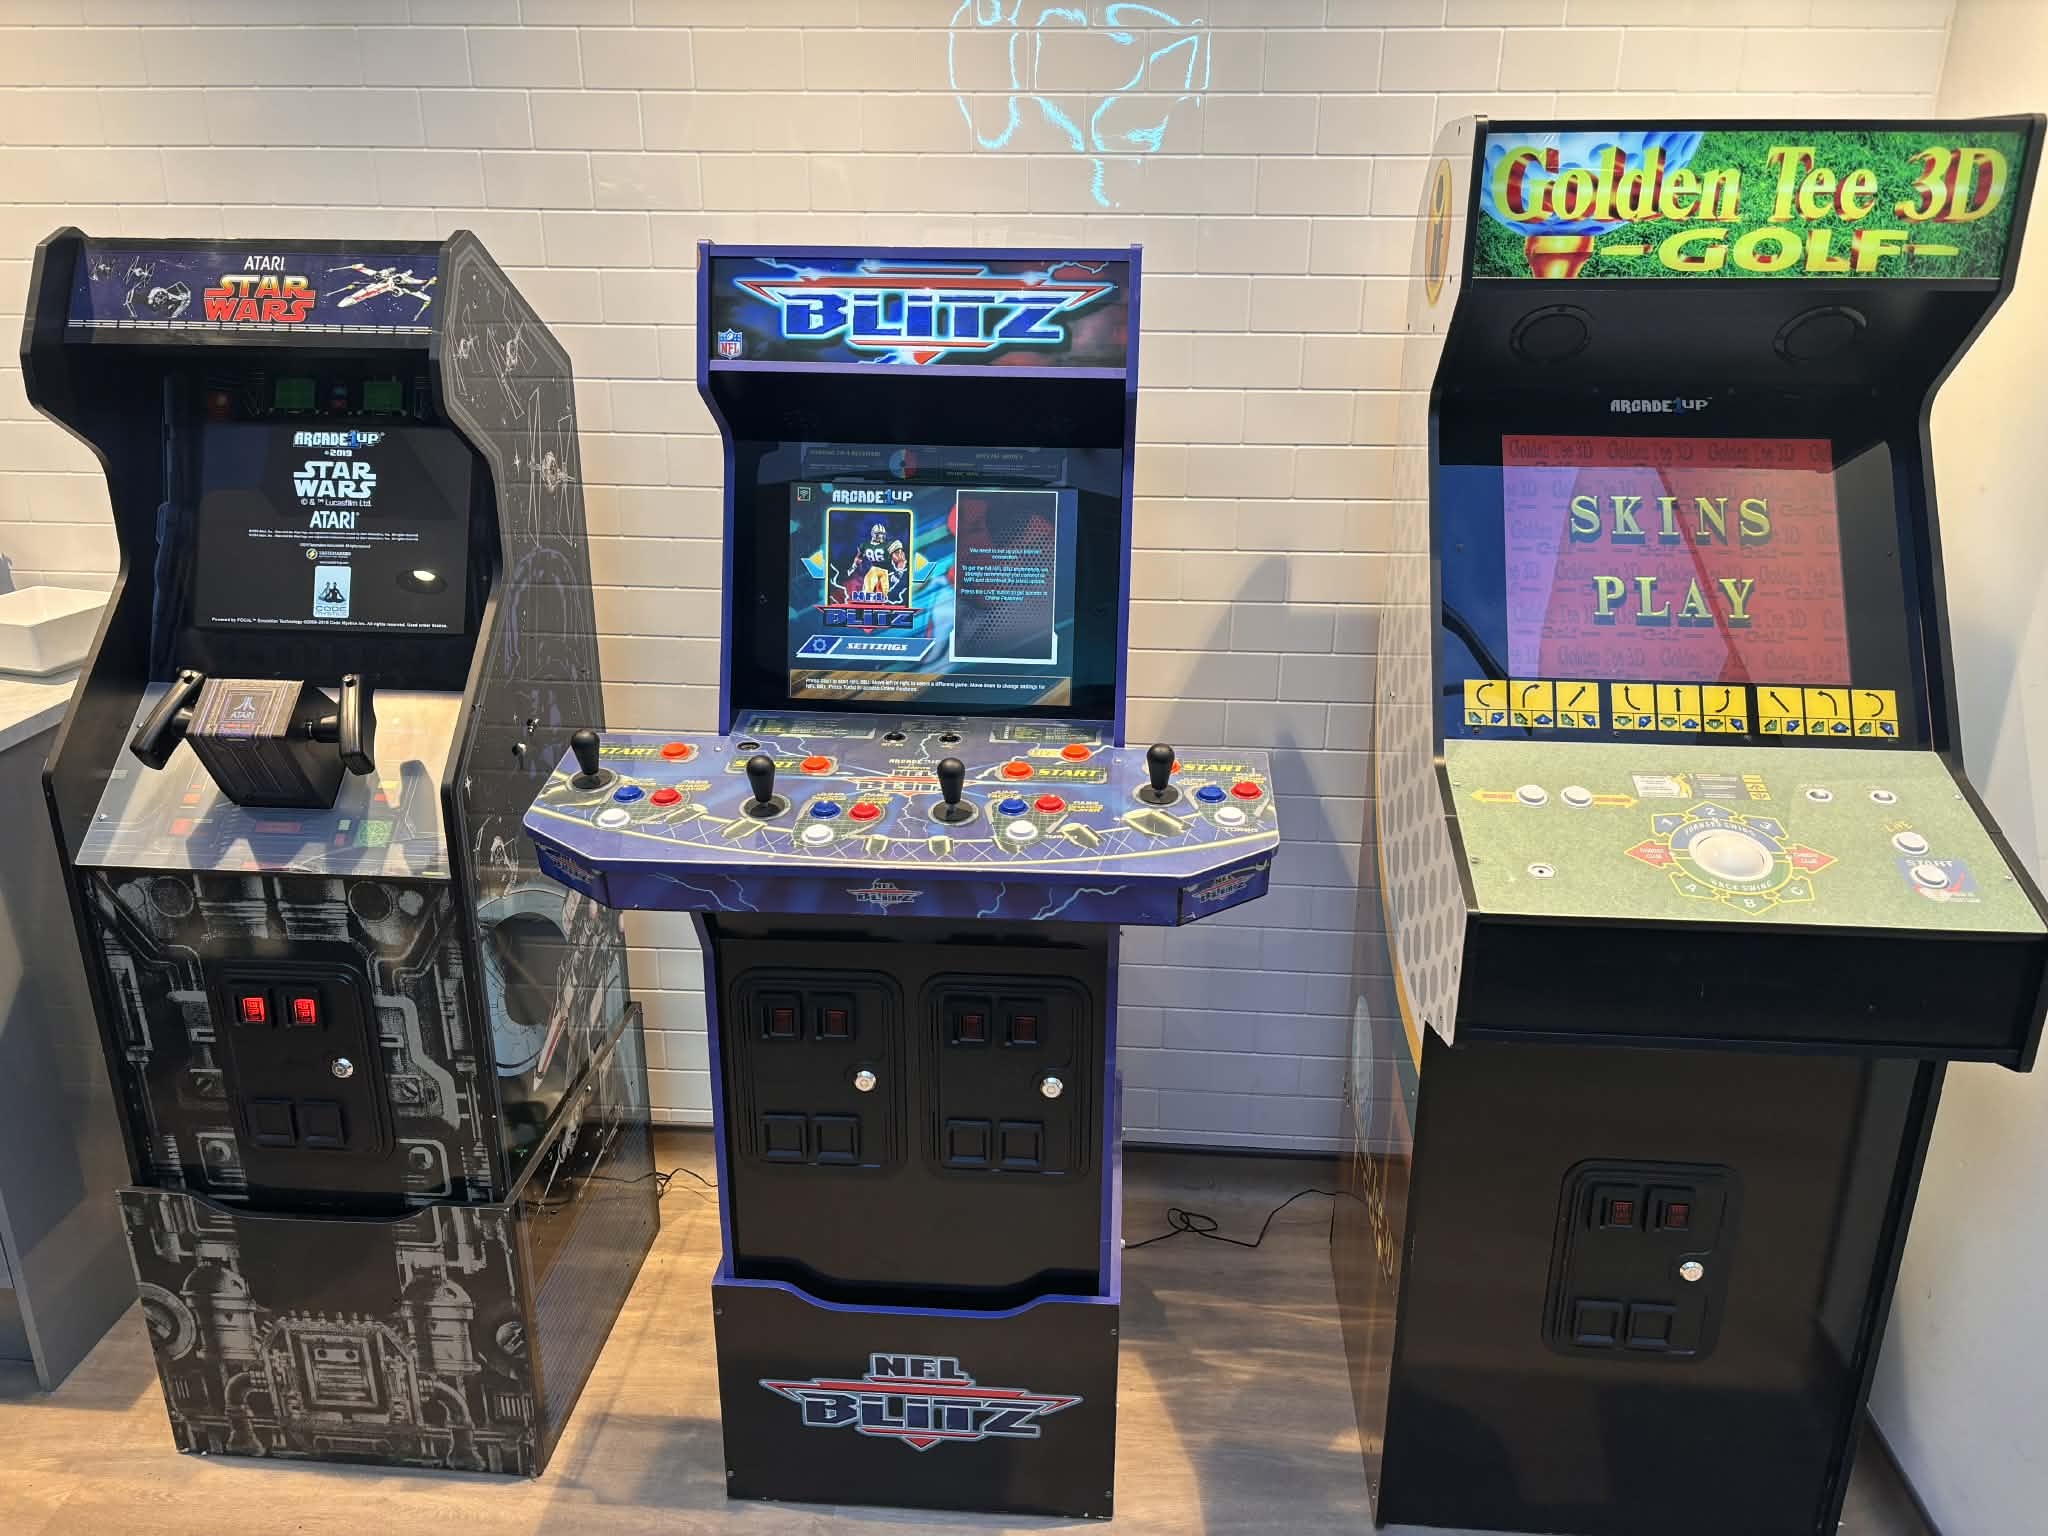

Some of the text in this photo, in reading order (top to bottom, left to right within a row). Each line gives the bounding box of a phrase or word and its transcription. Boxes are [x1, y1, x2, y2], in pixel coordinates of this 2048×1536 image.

[1502, 146, 2009, 223] Golden Tee 3D
[1657, 228, 1910, 272] GOLF
[244, 255, 285, 270] ATARI
[204, 274, 316, 299] STAR
[204, 297, 315, 322] WARS
[776, 291, 1072, 341] BLITZ
[721, 342, 741, 355] NFL
[293, 460, 376, 480] STAR
[293, 480, 376, 498] WARS
[325, 499, 358, 507] Lucasfilm
[309, 510, 355, 528] ATARI
[1570, 494, 1773, 544] SKINS
[1592, 574, 1756, 624] PLAY
[847, 642, 908, 651] SETTINGS
[230, 711, 256, 719] ATARI
[1039, 768, 1097, 778] START
[1183, 763, 1245, 772] START
[1705, 807, 1718, 816] 2
[1685, 883, 1698, 893] A
[1790, 886, 1804, 896] C
[1743, 898, 1758, 908] B
[870, 1354, 969, 1379] NFL
[794, 1392, 1041, 1438] BLITZ
